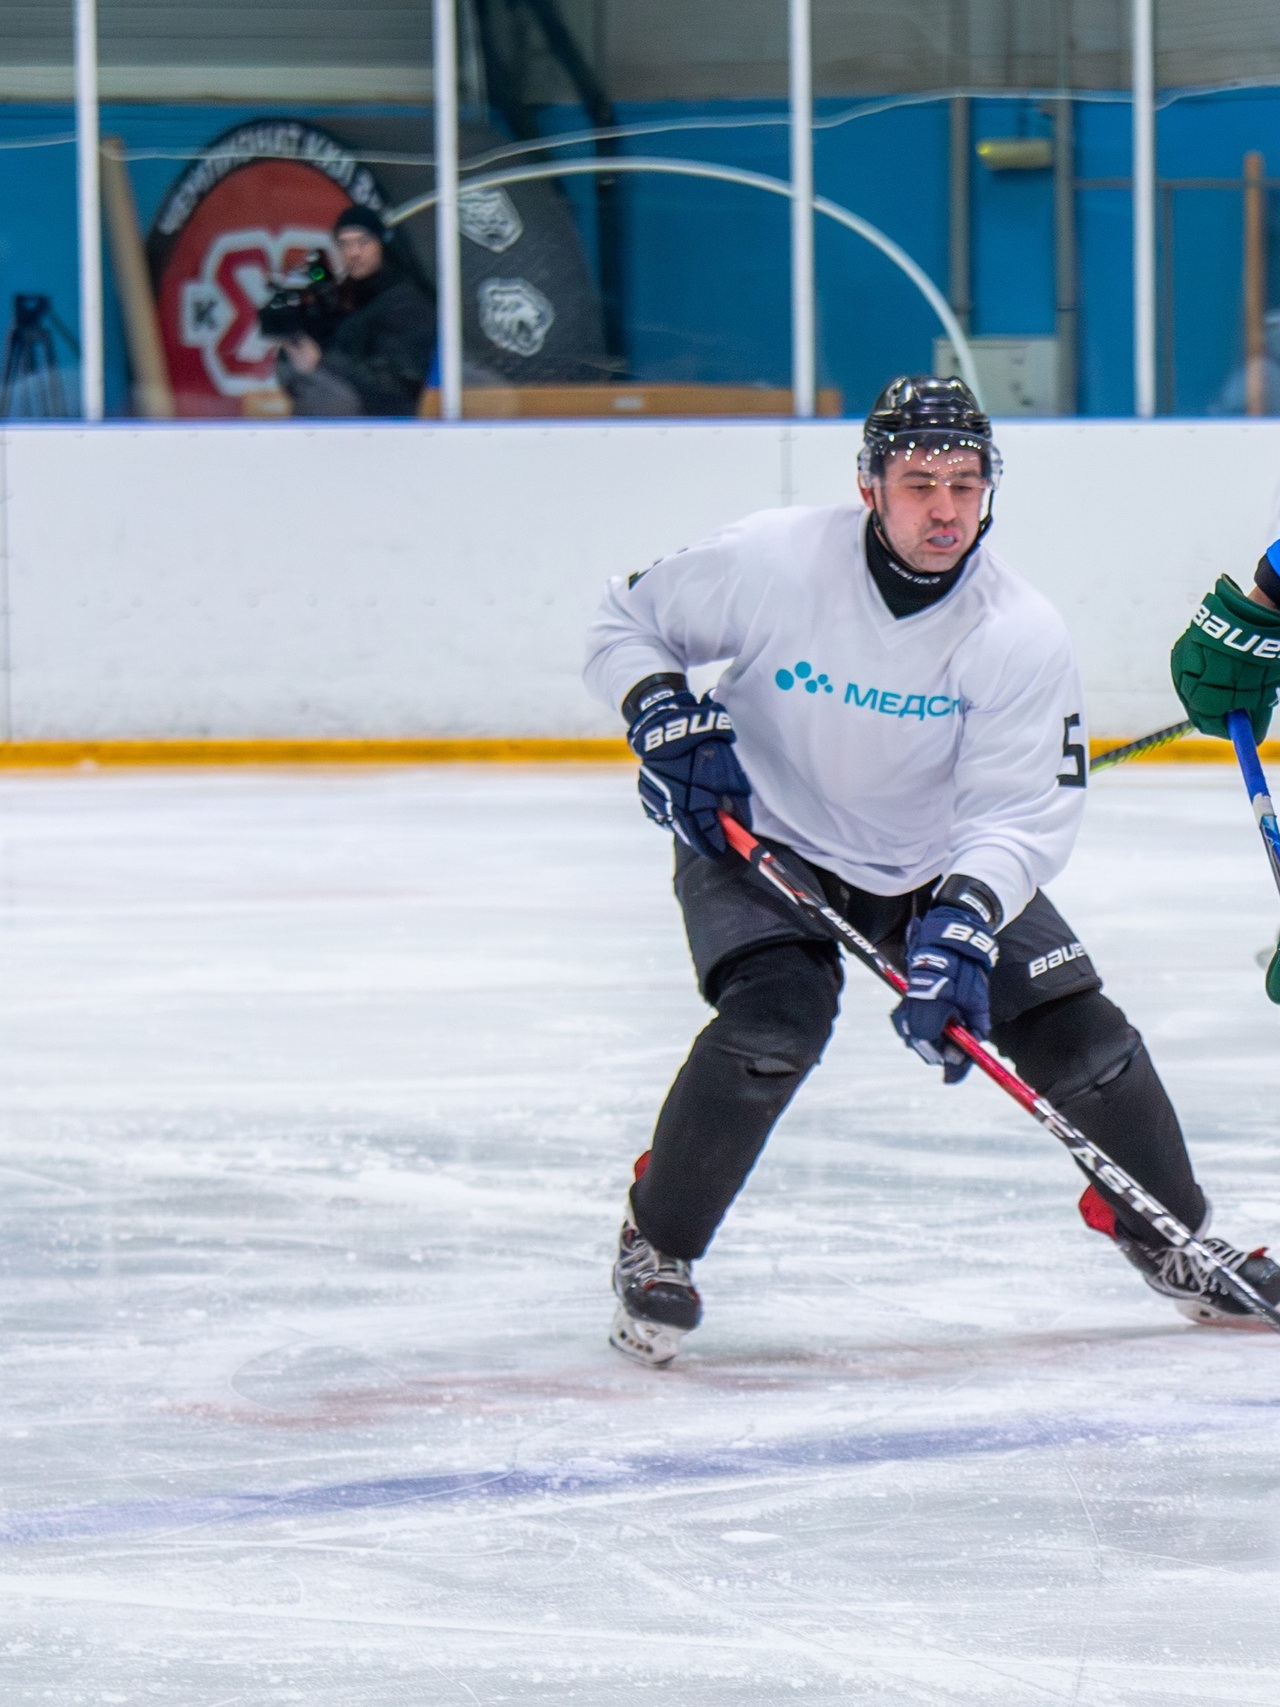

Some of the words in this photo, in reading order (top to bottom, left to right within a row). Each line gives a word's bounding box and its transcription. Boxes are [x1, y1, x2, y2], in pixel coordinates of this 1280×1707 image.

[644, 709, 733, 752] BAUE
[1056, 713, 1087, 788] 5
[820, 906, 878, 955] EASTON
[1028, 941, 1086, 979] BAUE
